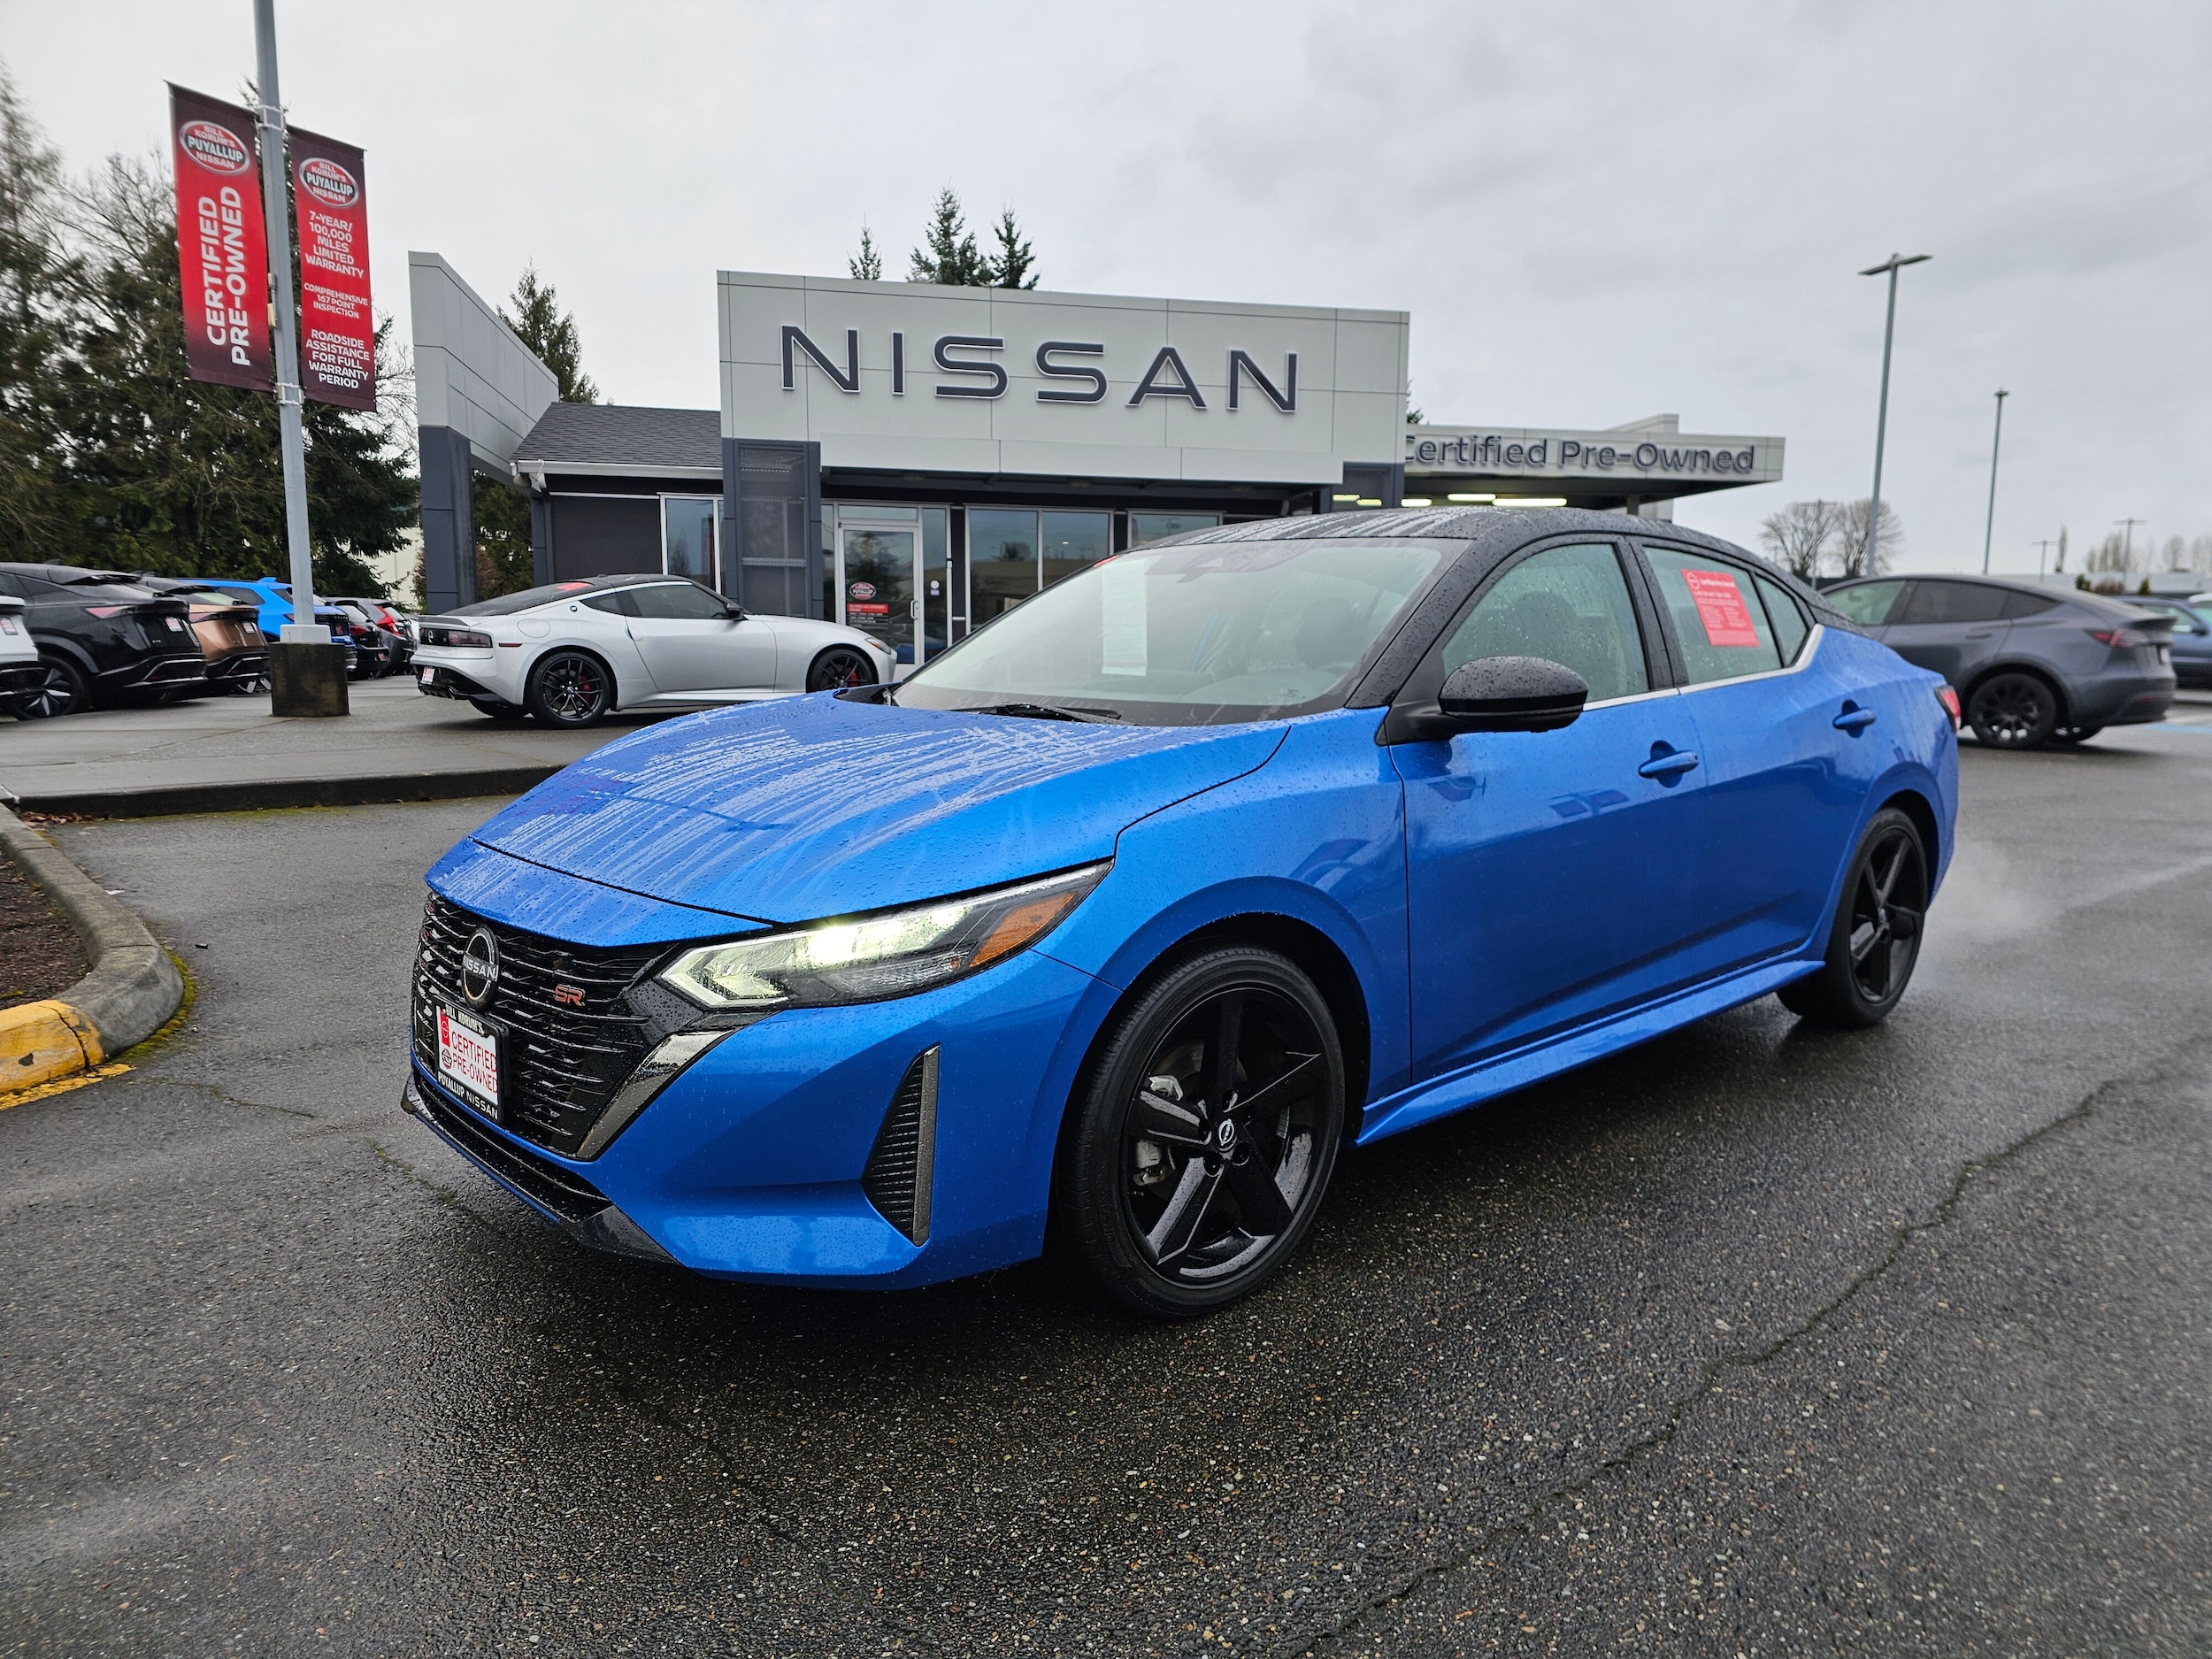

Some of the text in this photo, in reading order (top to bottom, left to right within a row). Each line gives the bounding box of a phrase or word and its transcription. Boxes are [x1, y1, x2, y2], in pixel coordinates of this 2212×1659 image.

[195, 129, 235, 148] KORUM'S
[204, 124, 224, 137] BILL
[188, 135, 243, 162] PUYALLUP
[196, 150, 235, 169] NISSAN
[319, 162, 336, 173] BILL
[306, 172, 353, 196] PUYALLUP
[311, 165, 346, 182] KORUM'S
[313, 186, 346, 203] NISSAN
[309, 210, 353, 232] 7-YEAR/
[309, 221, 352, 242] 100,000
[318, 235, 349, 252] MILES
[313, 244, 354, 265] LIMITED
[198, 196, 227, 346] CERTIFIED
[220, 186, 251, 366] PRE-OWNED
[305, 253, 364, 279] WARRANTY
[303, 282, 368, 306] COMPREHENSIVE
[317, 294, 355, 310] 167 POINT
[313, 301, 359, 319] INSPECTION
[311, 328, 365, 349] ROADSIDE
[306, 339, 370, 361] ASSISTANCE
[311, 350, 363, 370] FOR FULL
[308, 360, 369, 380] WARRANTY
[781, 325, 1298, 412] NISSAN
[319, 373, 359, 388] PERIOD
[1558, 440, 1755, 473] Pre-Owned
[462, 955, 496, 980] NISSAN
[554, 983, 585, 1007] SR
[451, 1031, 497, 1072] CERTIFIED
[452, 1052, 497, 1094] PRE-OWNED
[438, 1071, 498, 1120] PUYALLUP NISSAN
